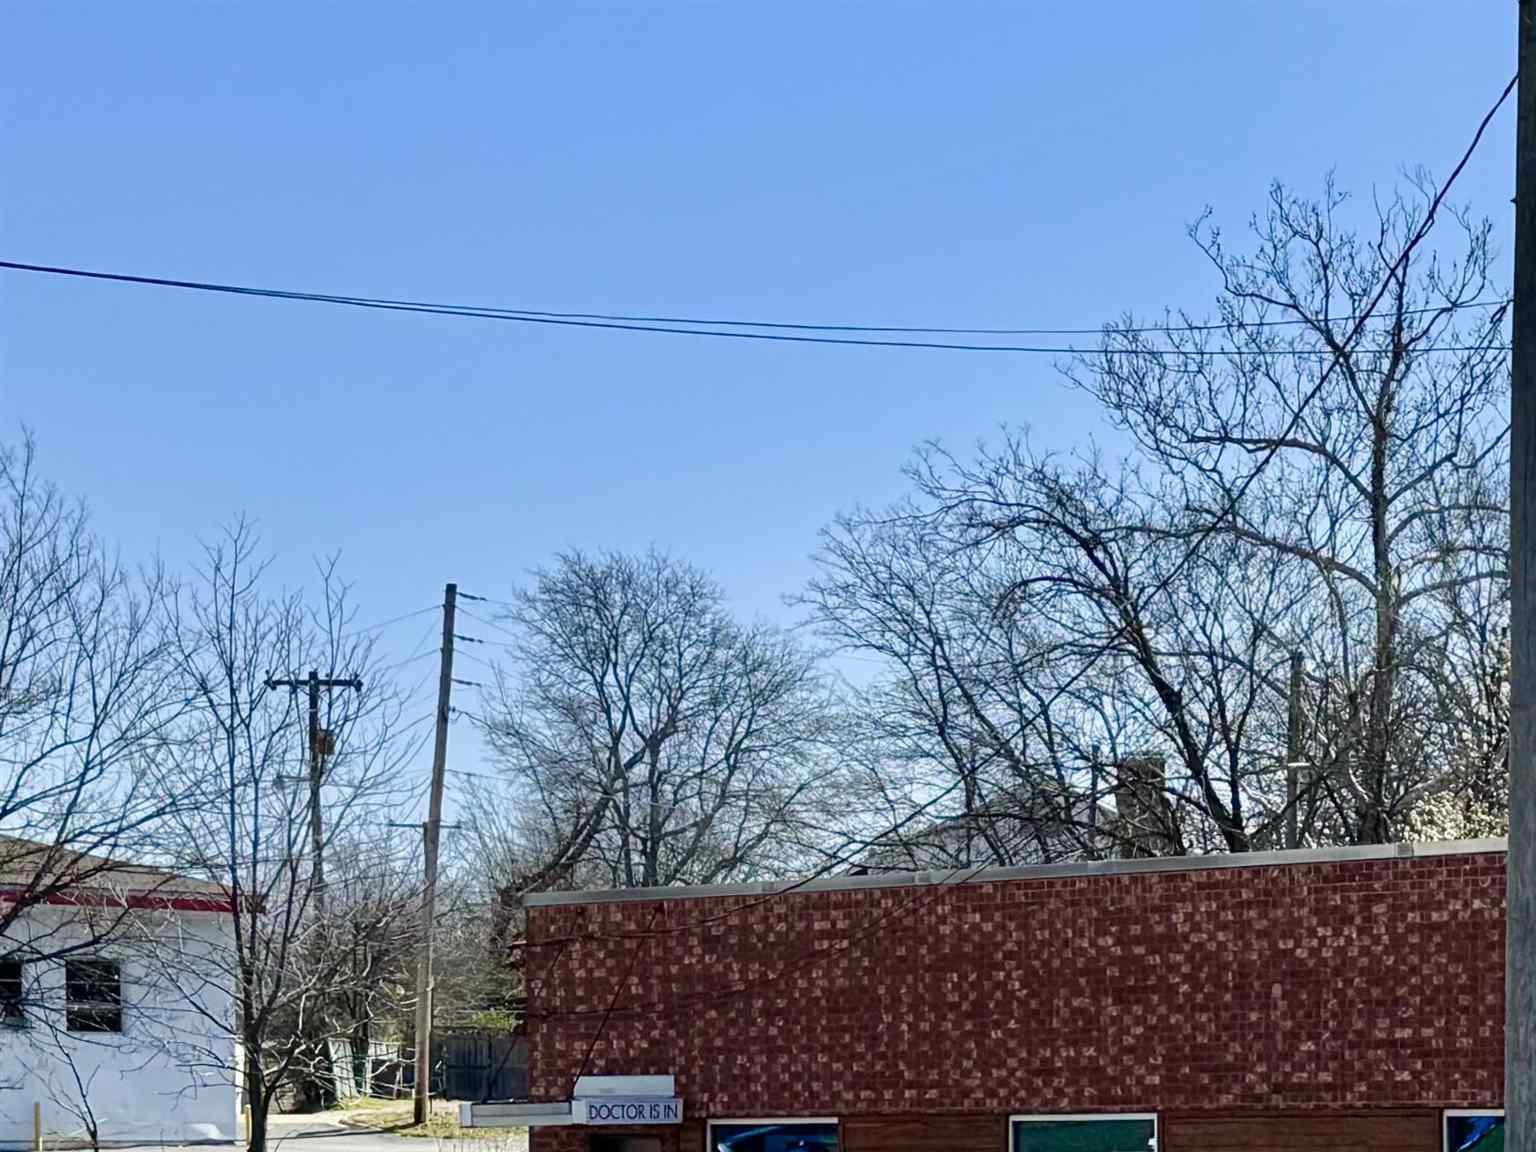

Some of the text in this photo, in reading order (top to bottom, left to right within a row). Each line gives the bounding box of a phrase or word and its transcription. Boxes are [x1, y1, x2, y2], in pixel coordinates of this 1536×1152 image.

[589, 1104, 678, 1120] DOCTOR IS IN
